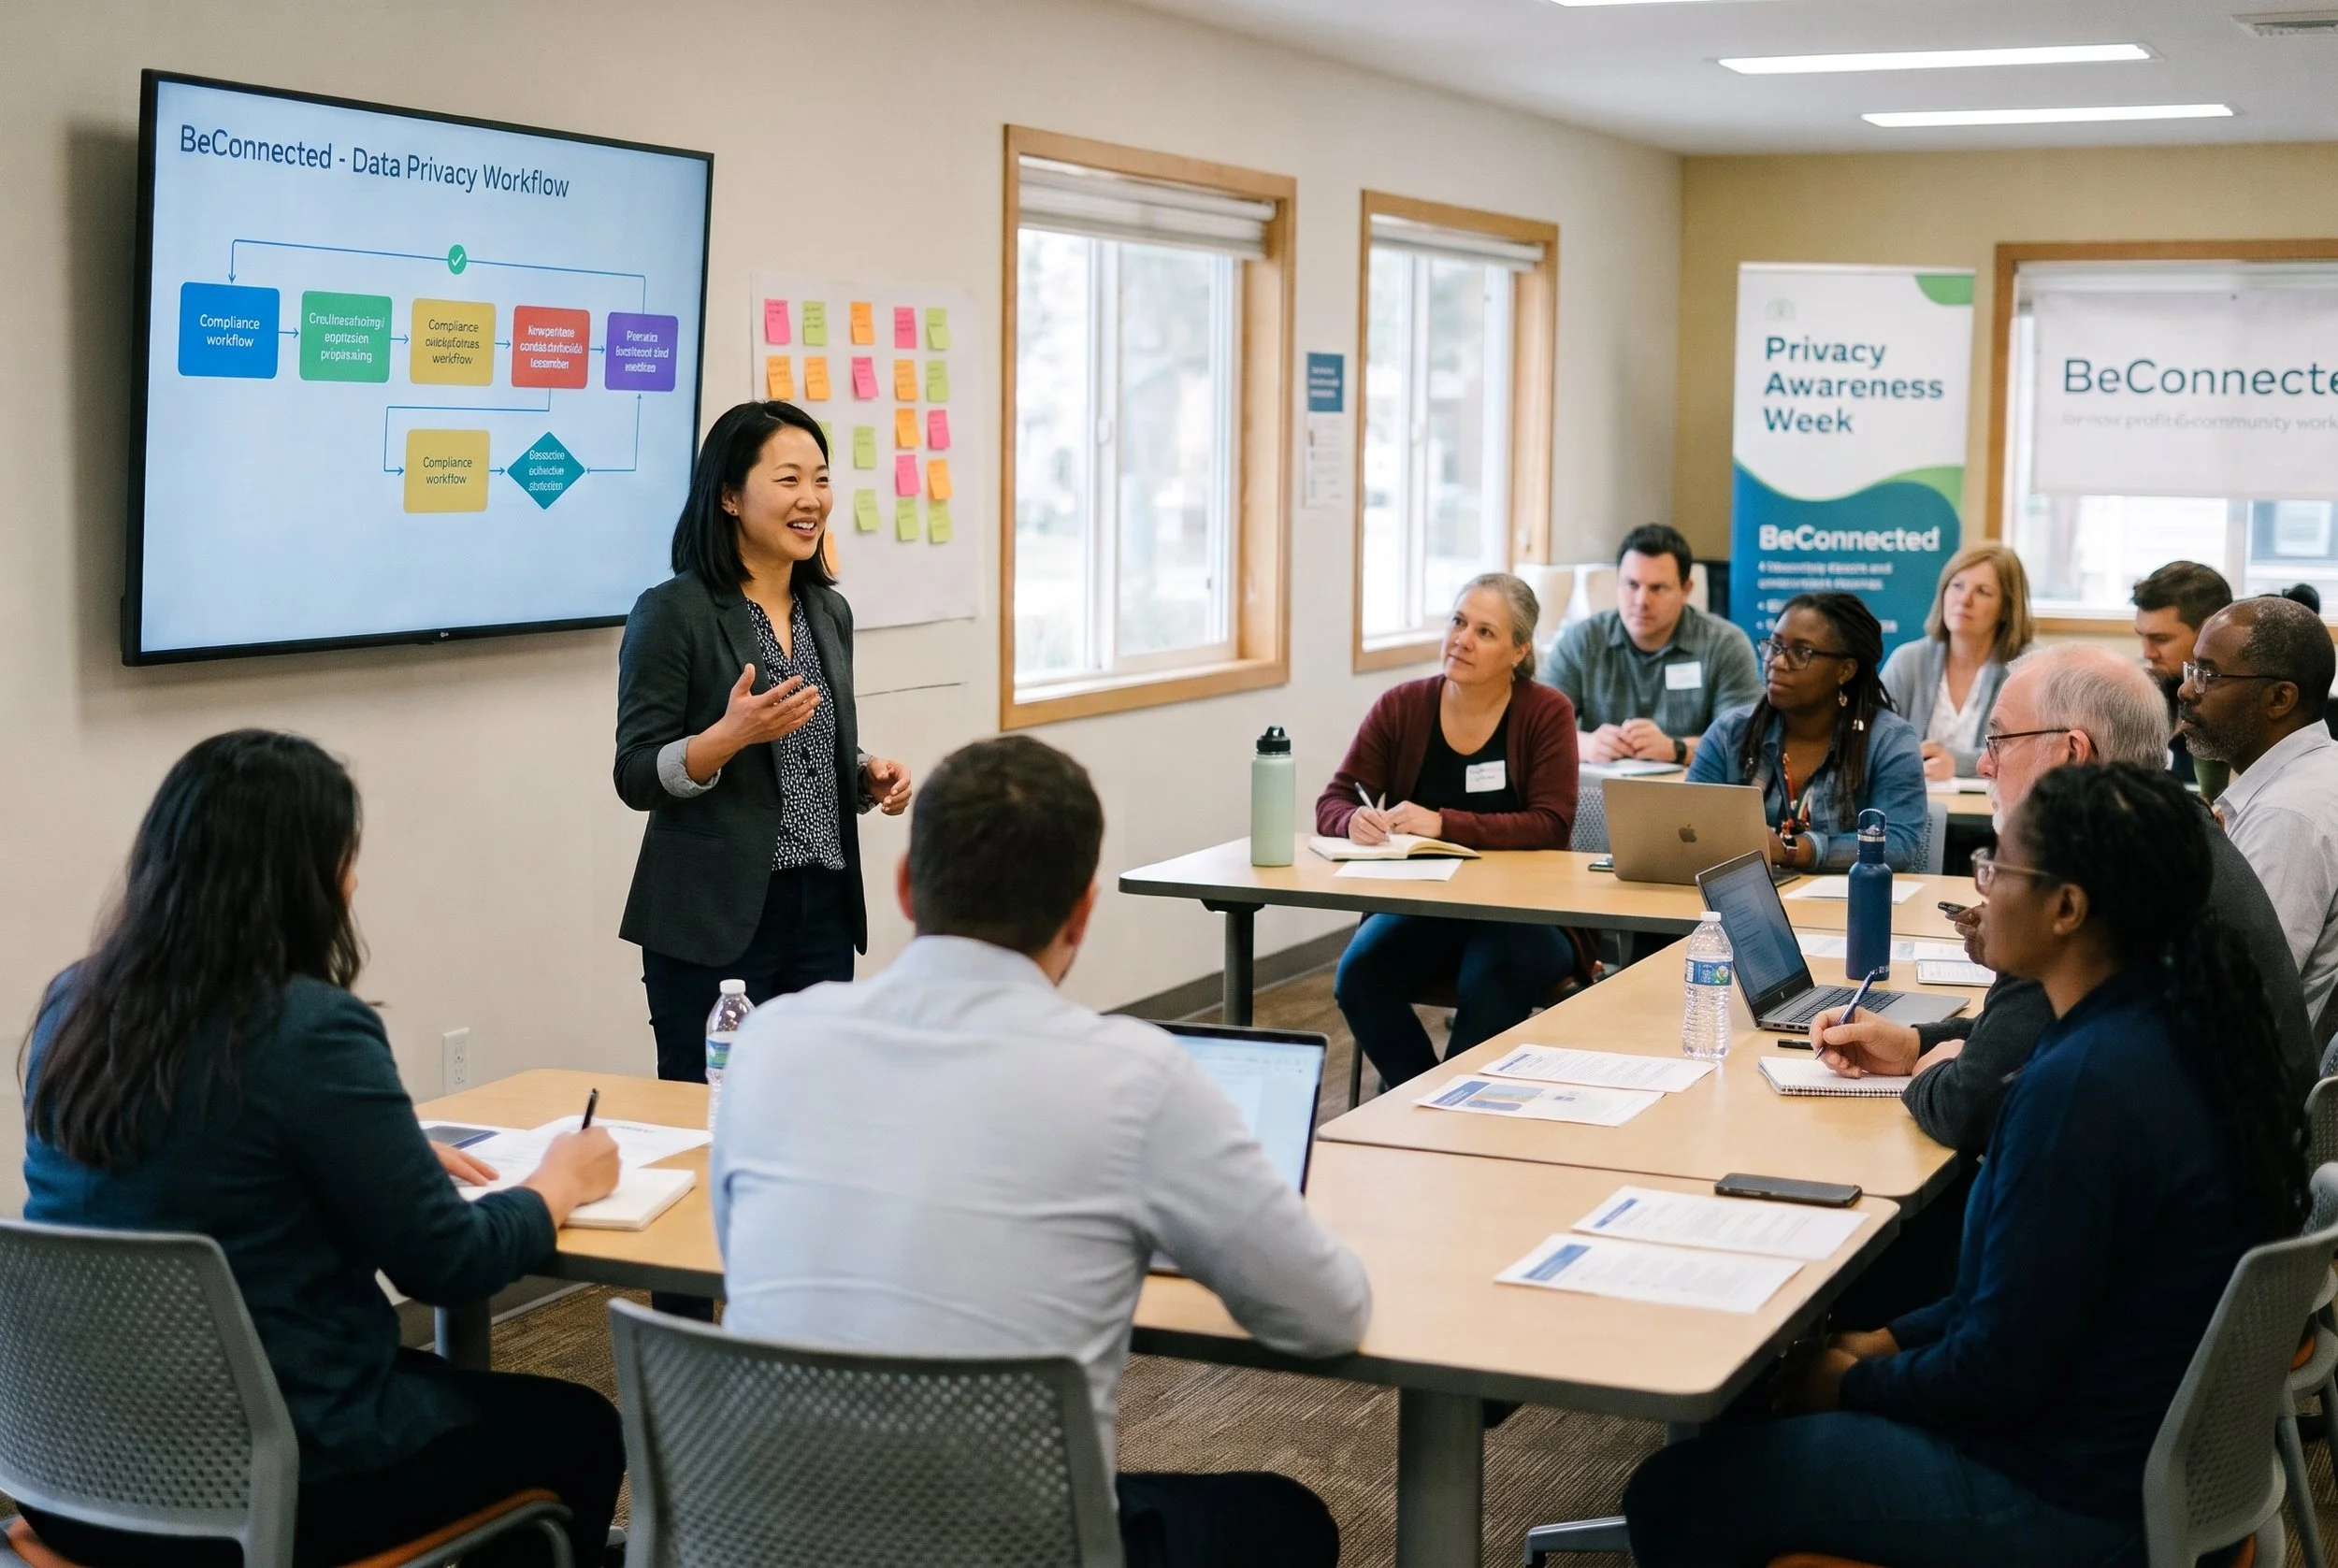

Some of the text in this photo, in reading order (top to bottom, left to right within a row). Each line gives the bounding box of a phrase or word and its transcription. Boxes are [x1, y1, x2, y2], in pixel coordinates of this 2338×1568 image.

[180, 123, 332, 169] BeConnected
[353, 147, 400, 178] Data
[407, 153, 478, 194] Privacy
[483, 164, 570, 198] Workflow
[199, 313, 261, 330] Compliance
[428, 318, 479, 333] Compliance
[206, 332, 254, 347] workflow
[1765, 335, 1886, 370] Privacy
[1764, 372, 1944, 399] Awareness
[1763, 406, 1855, 434] Week
[423, 455, 472, 469] Compliance
[1758, 524, 1941, 553] BeConnected
